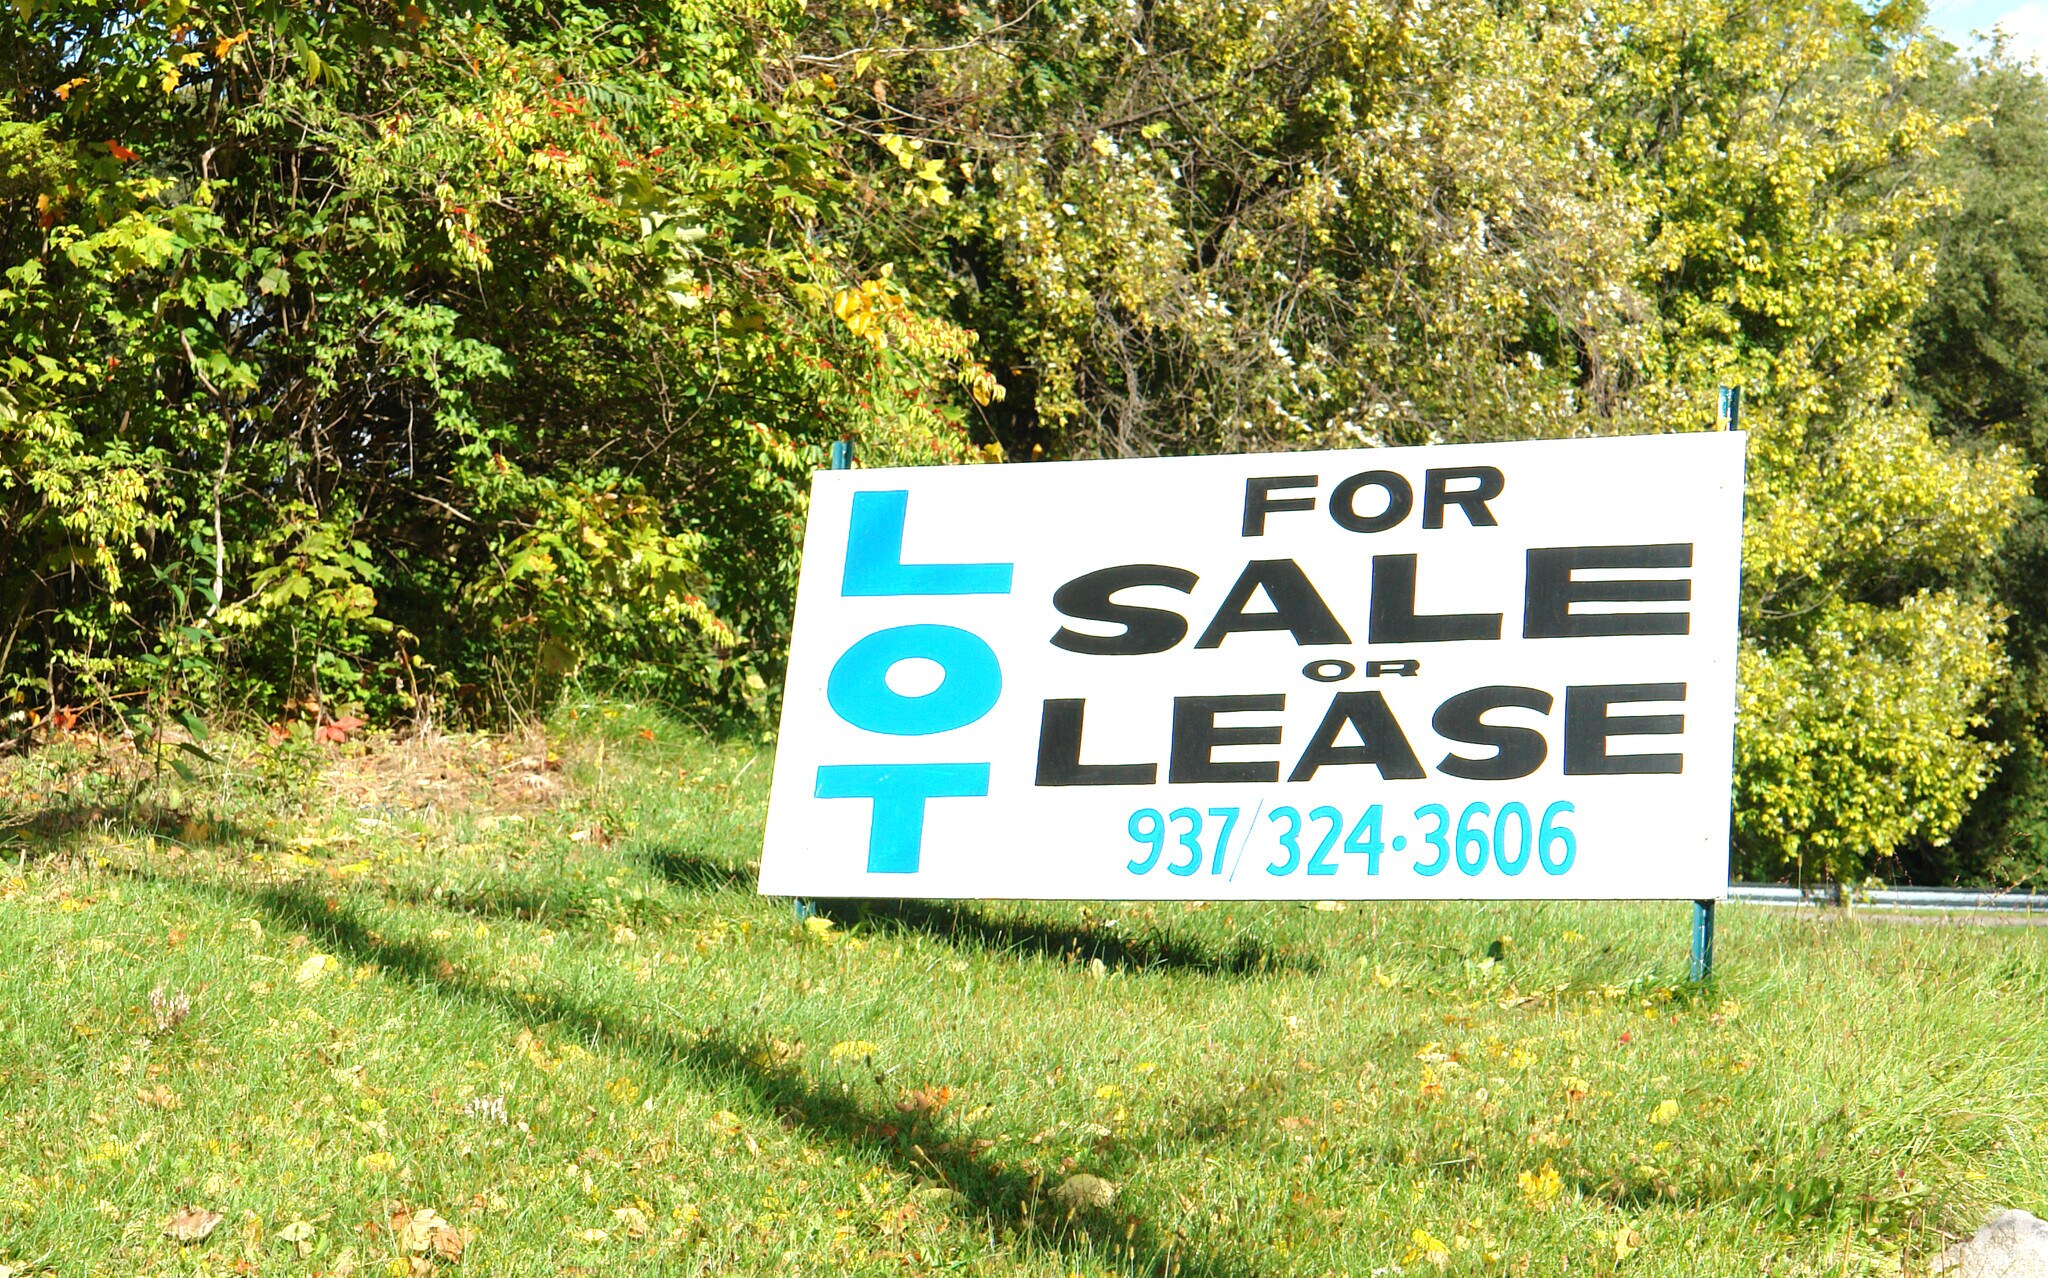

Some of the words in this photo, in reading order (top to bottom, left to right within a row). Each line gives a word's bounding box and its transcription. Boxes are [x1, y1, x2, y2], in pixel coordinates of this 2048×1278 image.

[1242, 466, 1503, 536] FOR
[1050, 543, 1692, 655] SALE
[814, 489, 1014, 874] LOT
[1302, 660, 1419, 683] OR
[1035, 683, 1686, 786] LEASE
